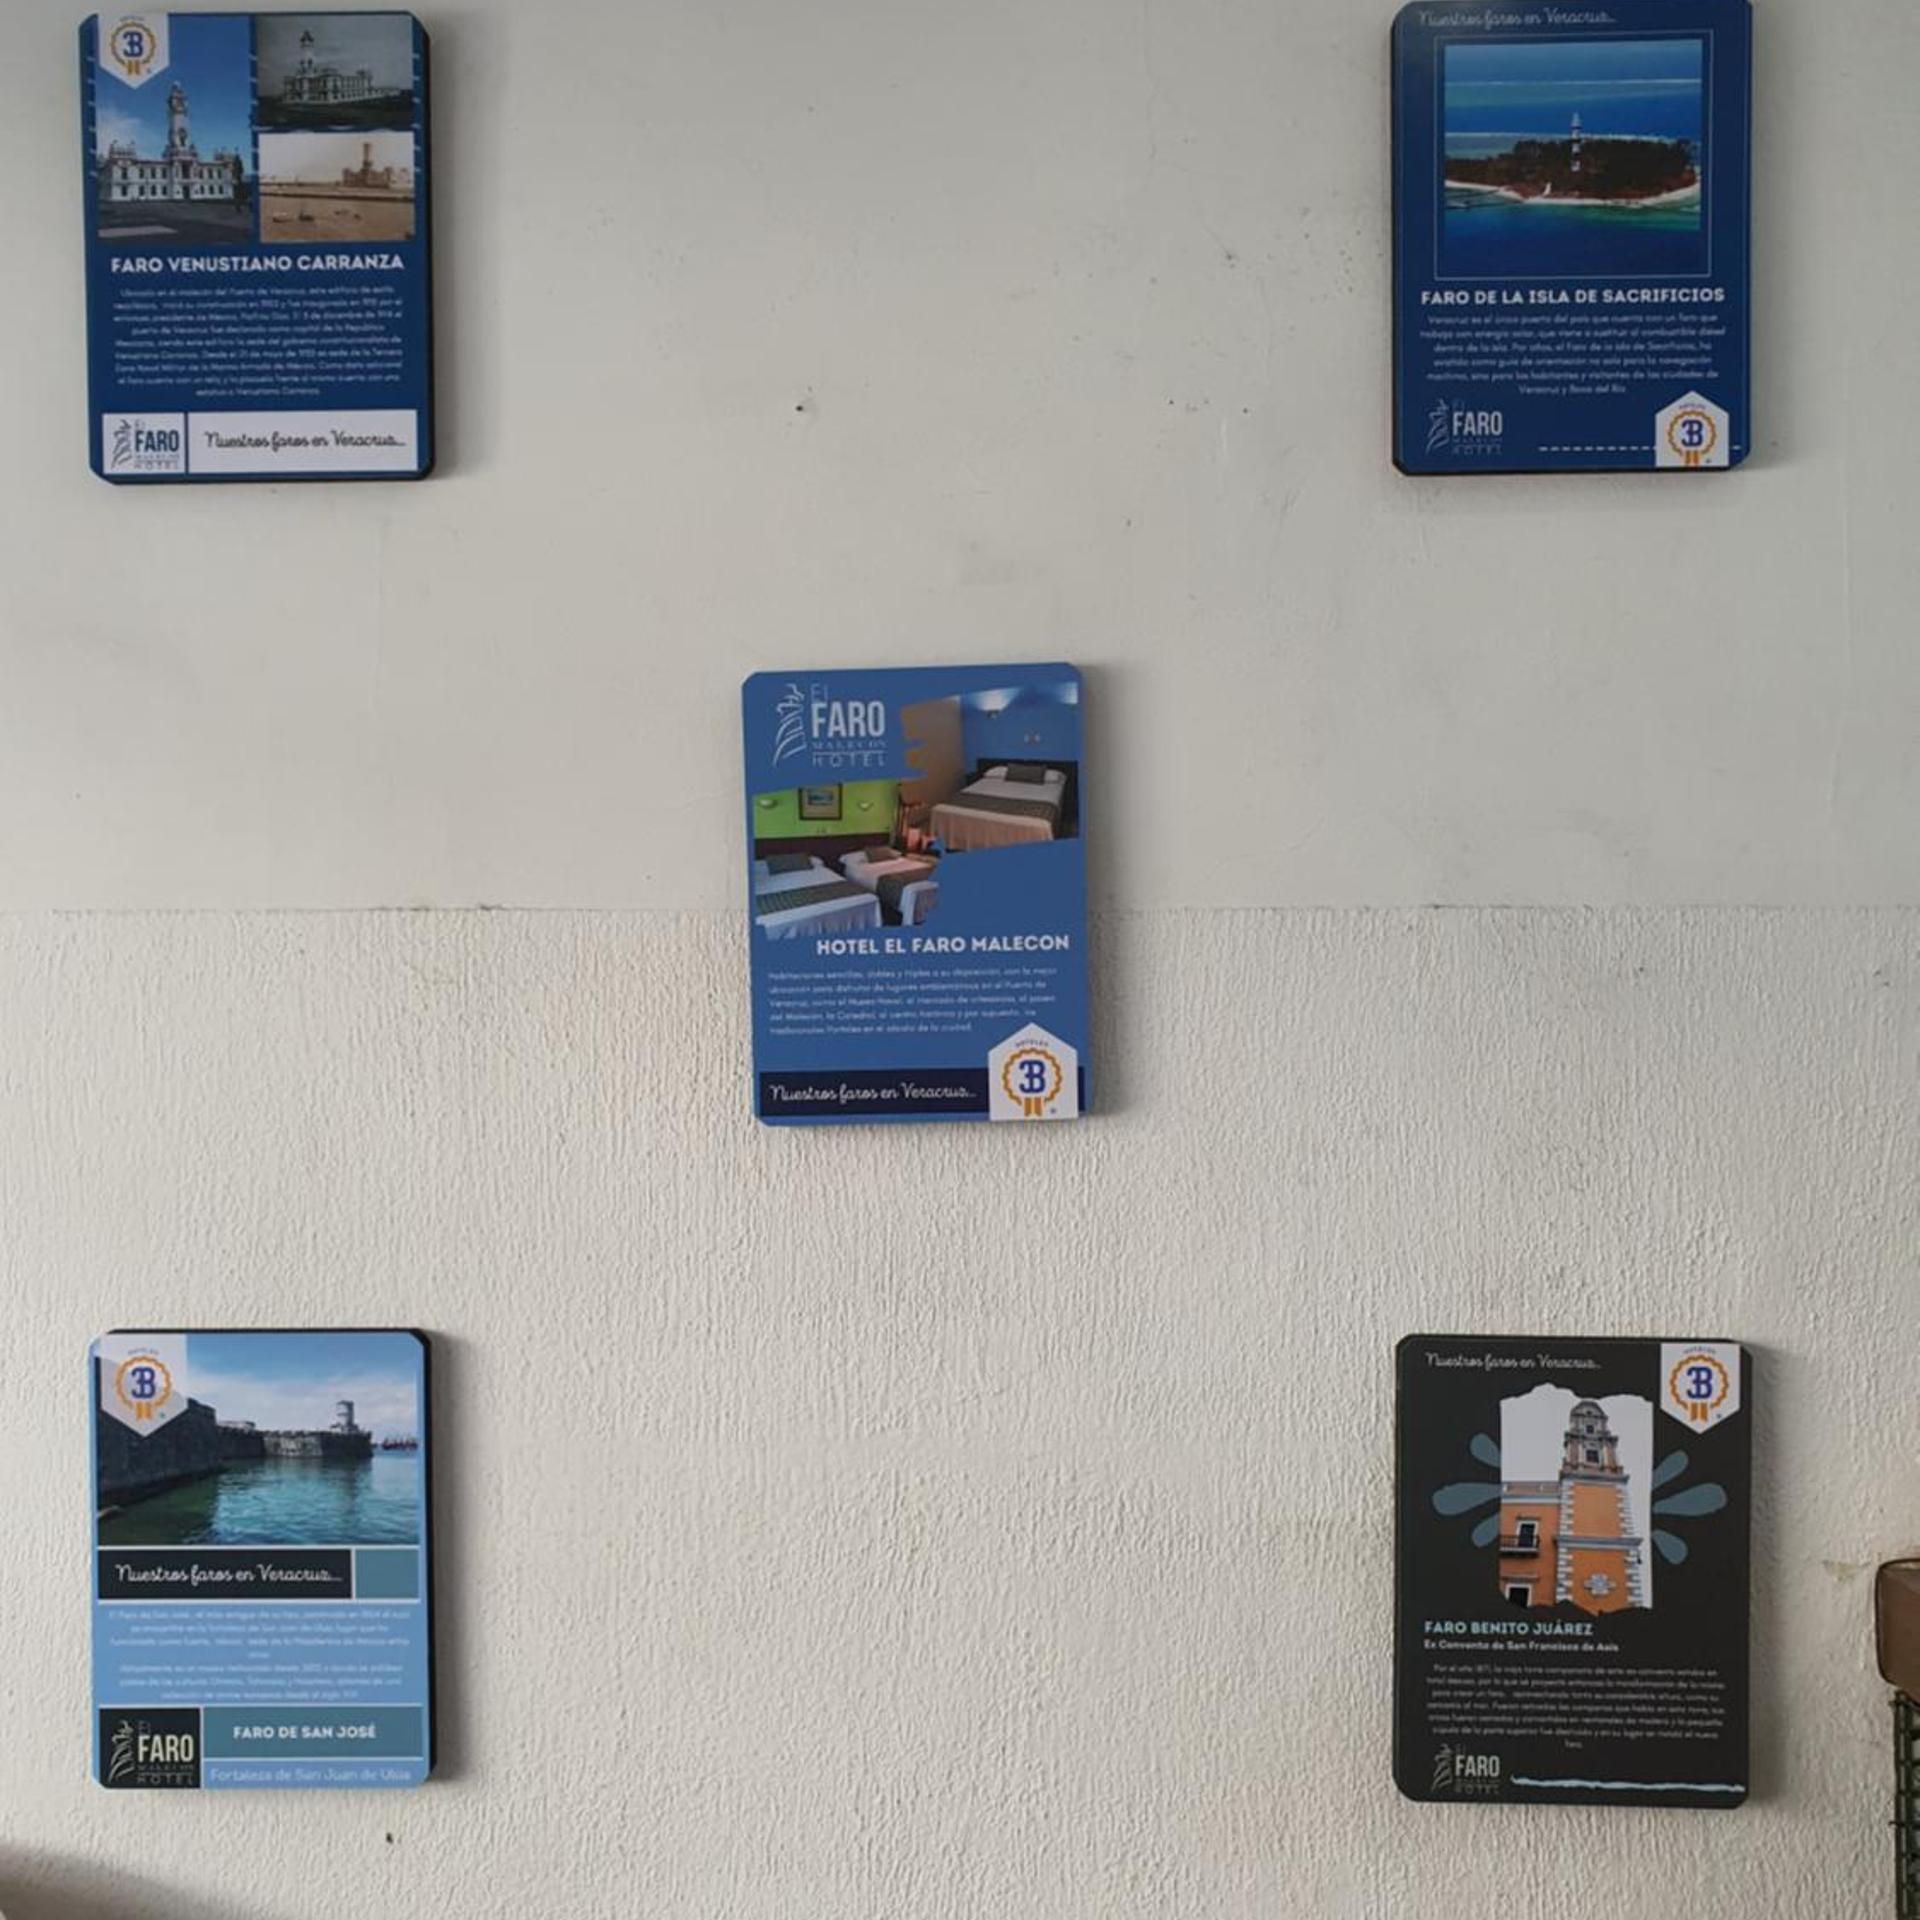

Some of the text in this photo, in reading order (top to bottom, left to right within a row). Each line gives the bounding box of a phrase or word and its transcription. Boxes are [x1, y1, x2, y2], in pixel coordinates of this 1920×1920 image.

[111, 254, 404, 273] FARO VENUSTIANO CARRANZA
[1421, 288, 1724, 304] FARO DE LA ISLA DE SACRIFICIOS
[1453, 411, 1502, 436] FARO
[134, 430, 180, 452] FARO
[204, 431, 270, 449] Nuestros
[272, 432, 310, 452] faros
[310, 435, 328, 448] en
[812, 701, 885, 738] FARO
[816, 935, 1069, 955] HOTEL EL FARO MALECON
[770, 1085, 837, 1101] Nuestros
[838, 1084, 878, 1103] faros
[880, 1088, 898, 1099] en
[1425, 1352, 1483, 1368] Nuestros
[1485, 1353, 1518, 1372] faros
[1520, 1357, 1536, 1368] en
[115, 1564, 188, 1582] Nuestros
[190, 1564, 233, 1586] faros
[235, 1568, 254, 1581] en
[1424, 1618, 1593, 1636] FARO BENITO JUÁREZ
[1424, 1640, 1436, 1650] Ex
[1439, 1640, 1490, 1650] Convento
[1492, 1640, 1504, 1650] de
[1508, 1641, 1526, 1650] San
[1529, 1641, 1579, 1651] Francisco
[1582, 1642, 1594, 1651] de
[233, 1723, 376, 1739] FARO DE SAN JOSÉ
[138, 1734, 194, 1762] FARO
[1455, 1756, 1500, 1776] FARO
